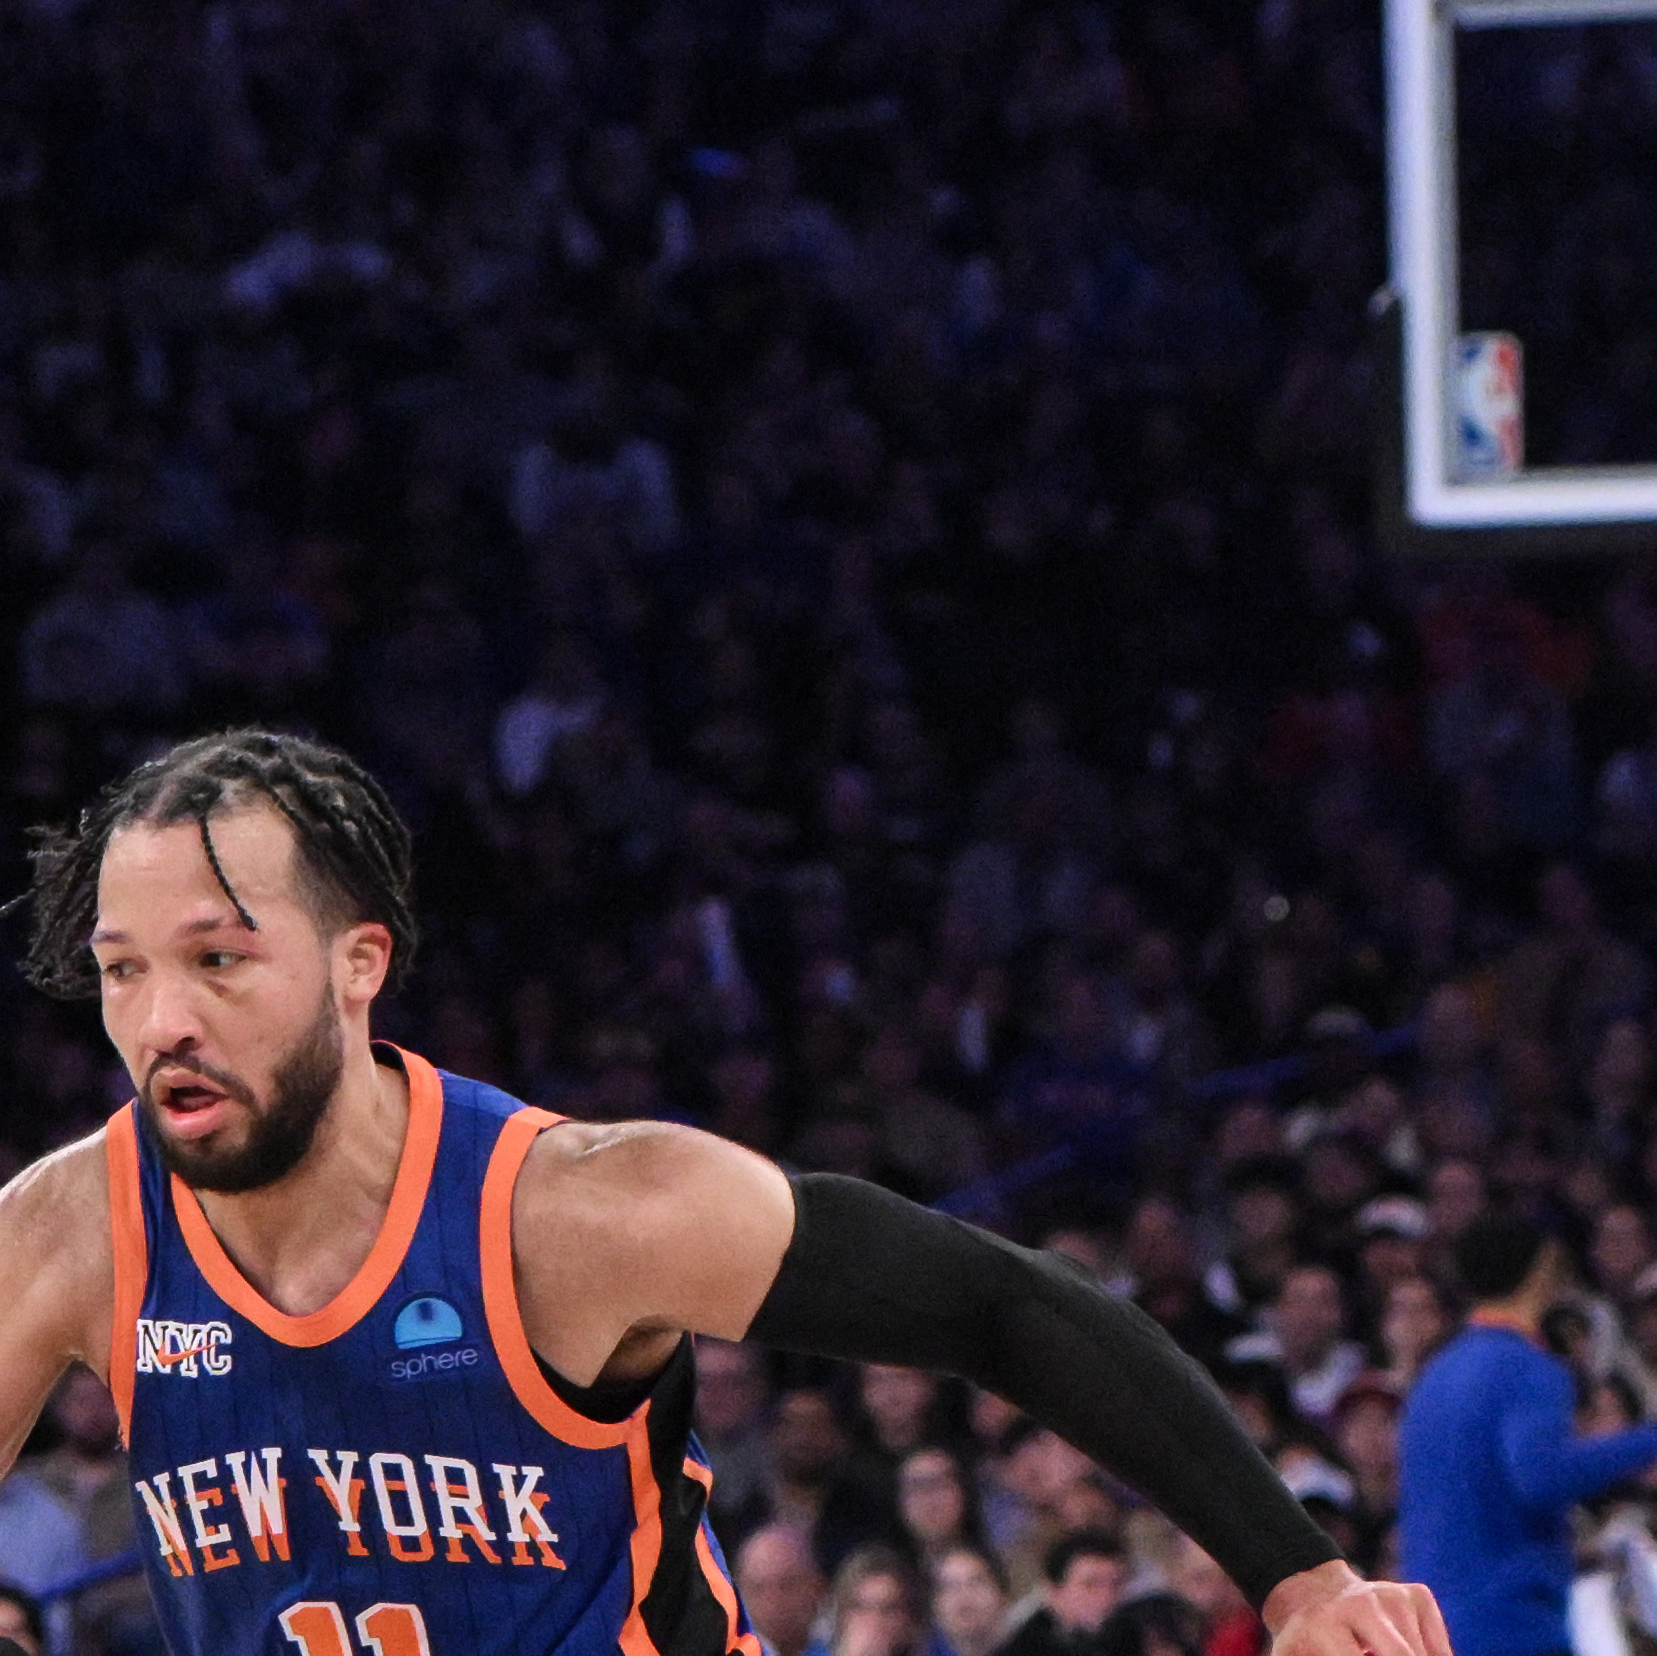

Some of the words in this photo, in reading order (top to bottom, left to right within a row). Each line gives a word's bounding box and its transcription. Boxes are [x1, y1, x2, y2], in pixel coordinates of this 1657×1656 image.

[136, 1318, 233, 1378] NYC
[390, 1346, 479, 1381] sphere
[135, 1446, 292, 1578] NEW
[307, 1448, 567, 1571] YORK
